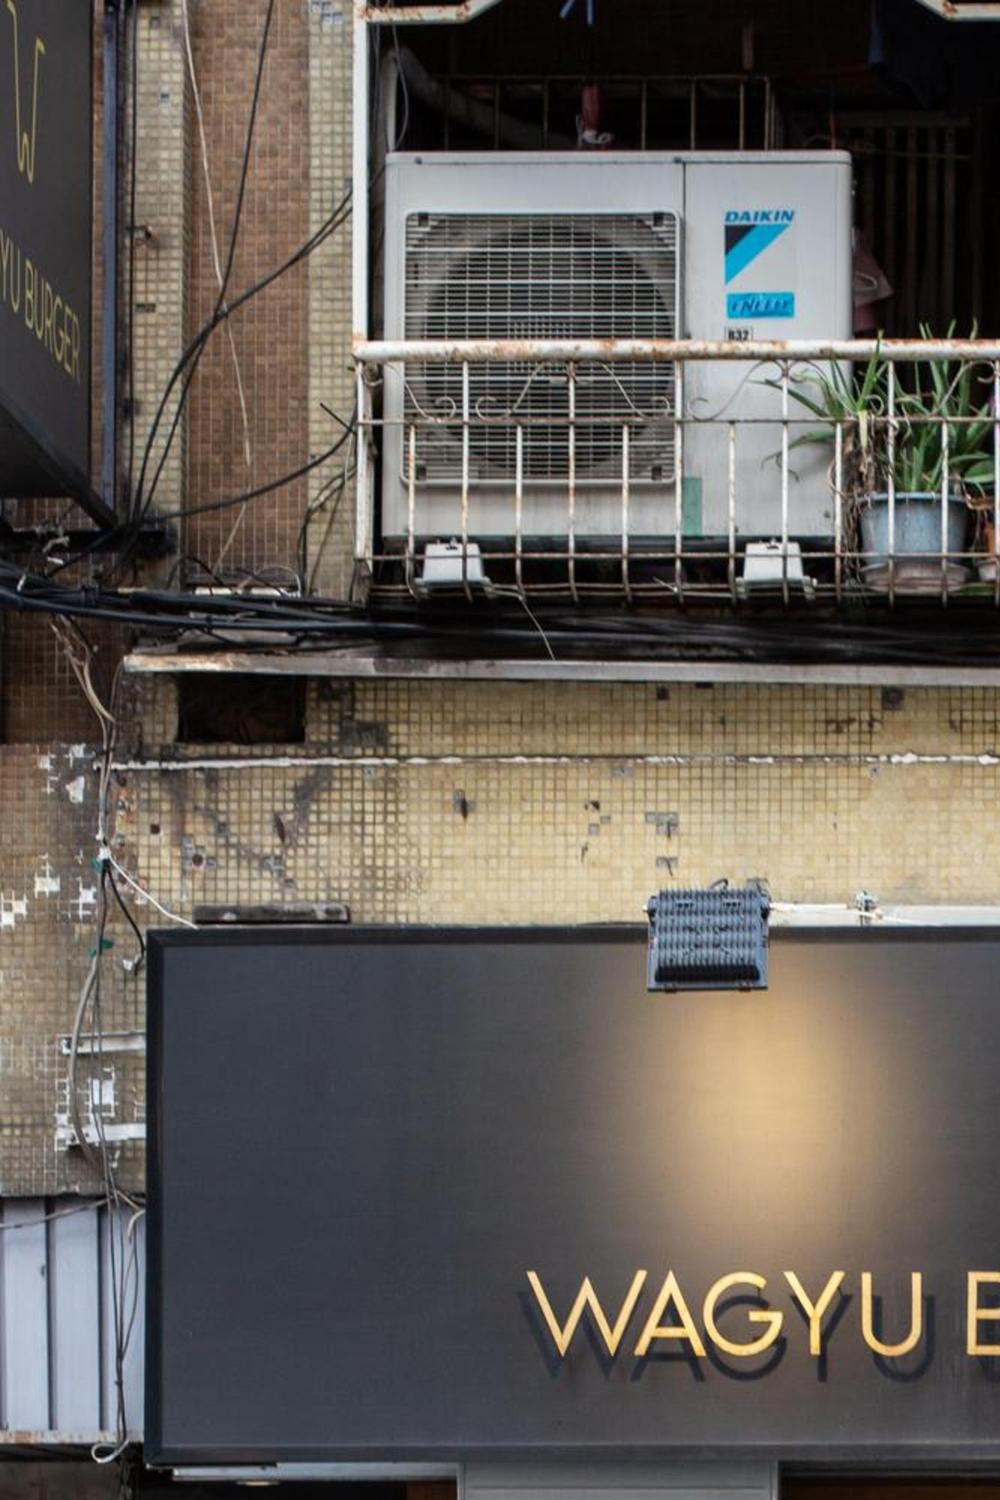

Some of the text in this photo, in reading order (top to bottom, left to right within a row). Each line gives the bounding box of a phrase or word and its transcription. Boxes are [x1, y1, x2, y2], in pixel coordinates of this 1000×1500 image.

[725, 209, 794, 223] DAIKIN
[25, 258, 80, 384] BURGER
[526, 1269, 922, 1358] WAGYU
